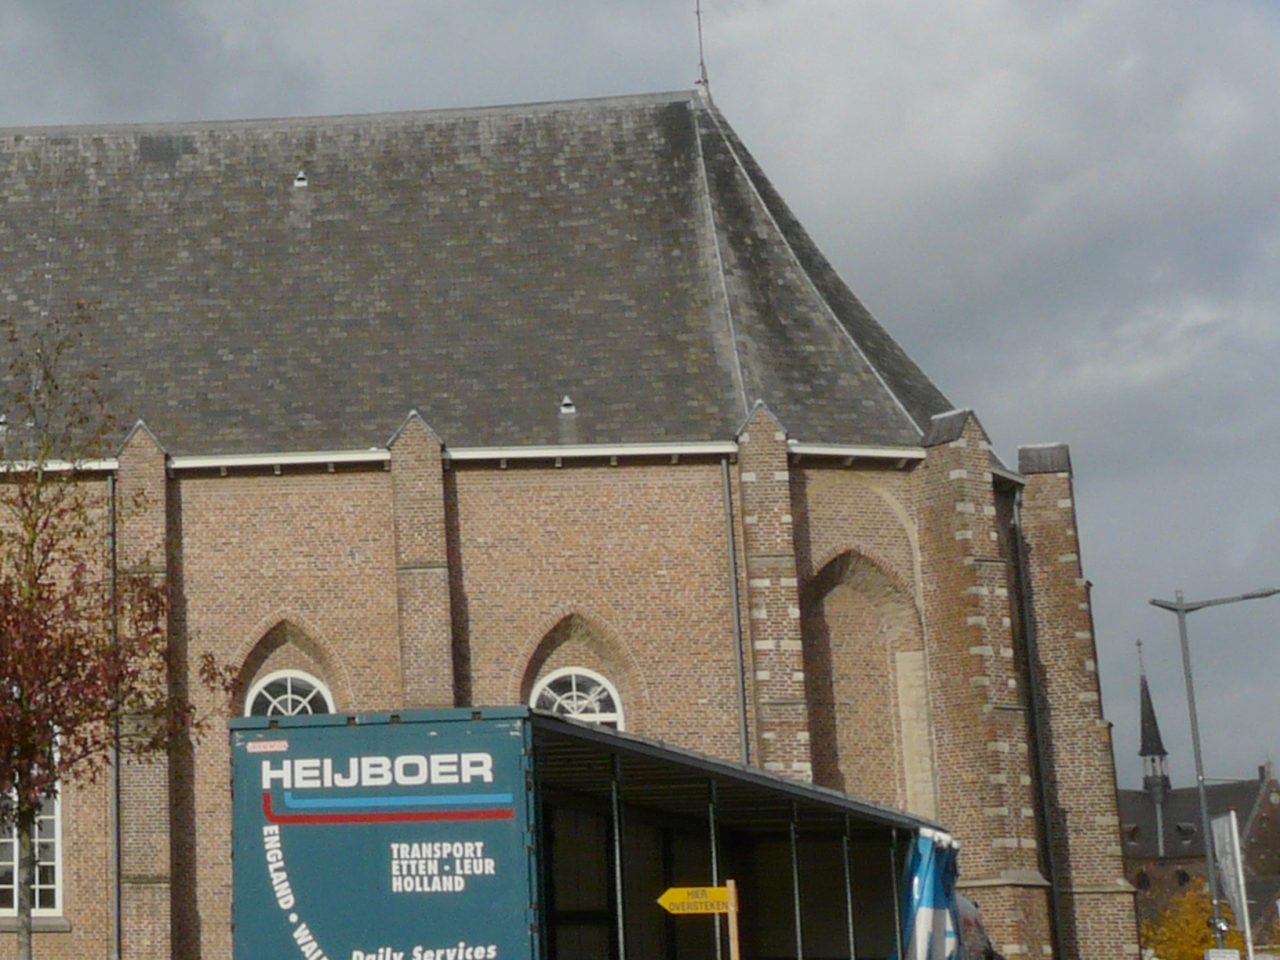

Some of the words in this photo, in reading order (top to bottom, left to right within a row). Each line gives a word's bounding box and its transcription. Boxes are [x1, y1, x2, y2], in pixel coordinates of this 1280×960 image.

[261, 752, 494, 789] HEIJBOER
[390, 841, 484, 859] TRANSPORT
[391, 859, 439, 875] ETTEN
[455, 858, 496, 875] LEUR
[262, 824, 295, 910] ENGLAND
[292, 922, 329, 960] WAL
[392, 875, 465, 892] HOLLAND
[411, 941, 498, 960] Services
